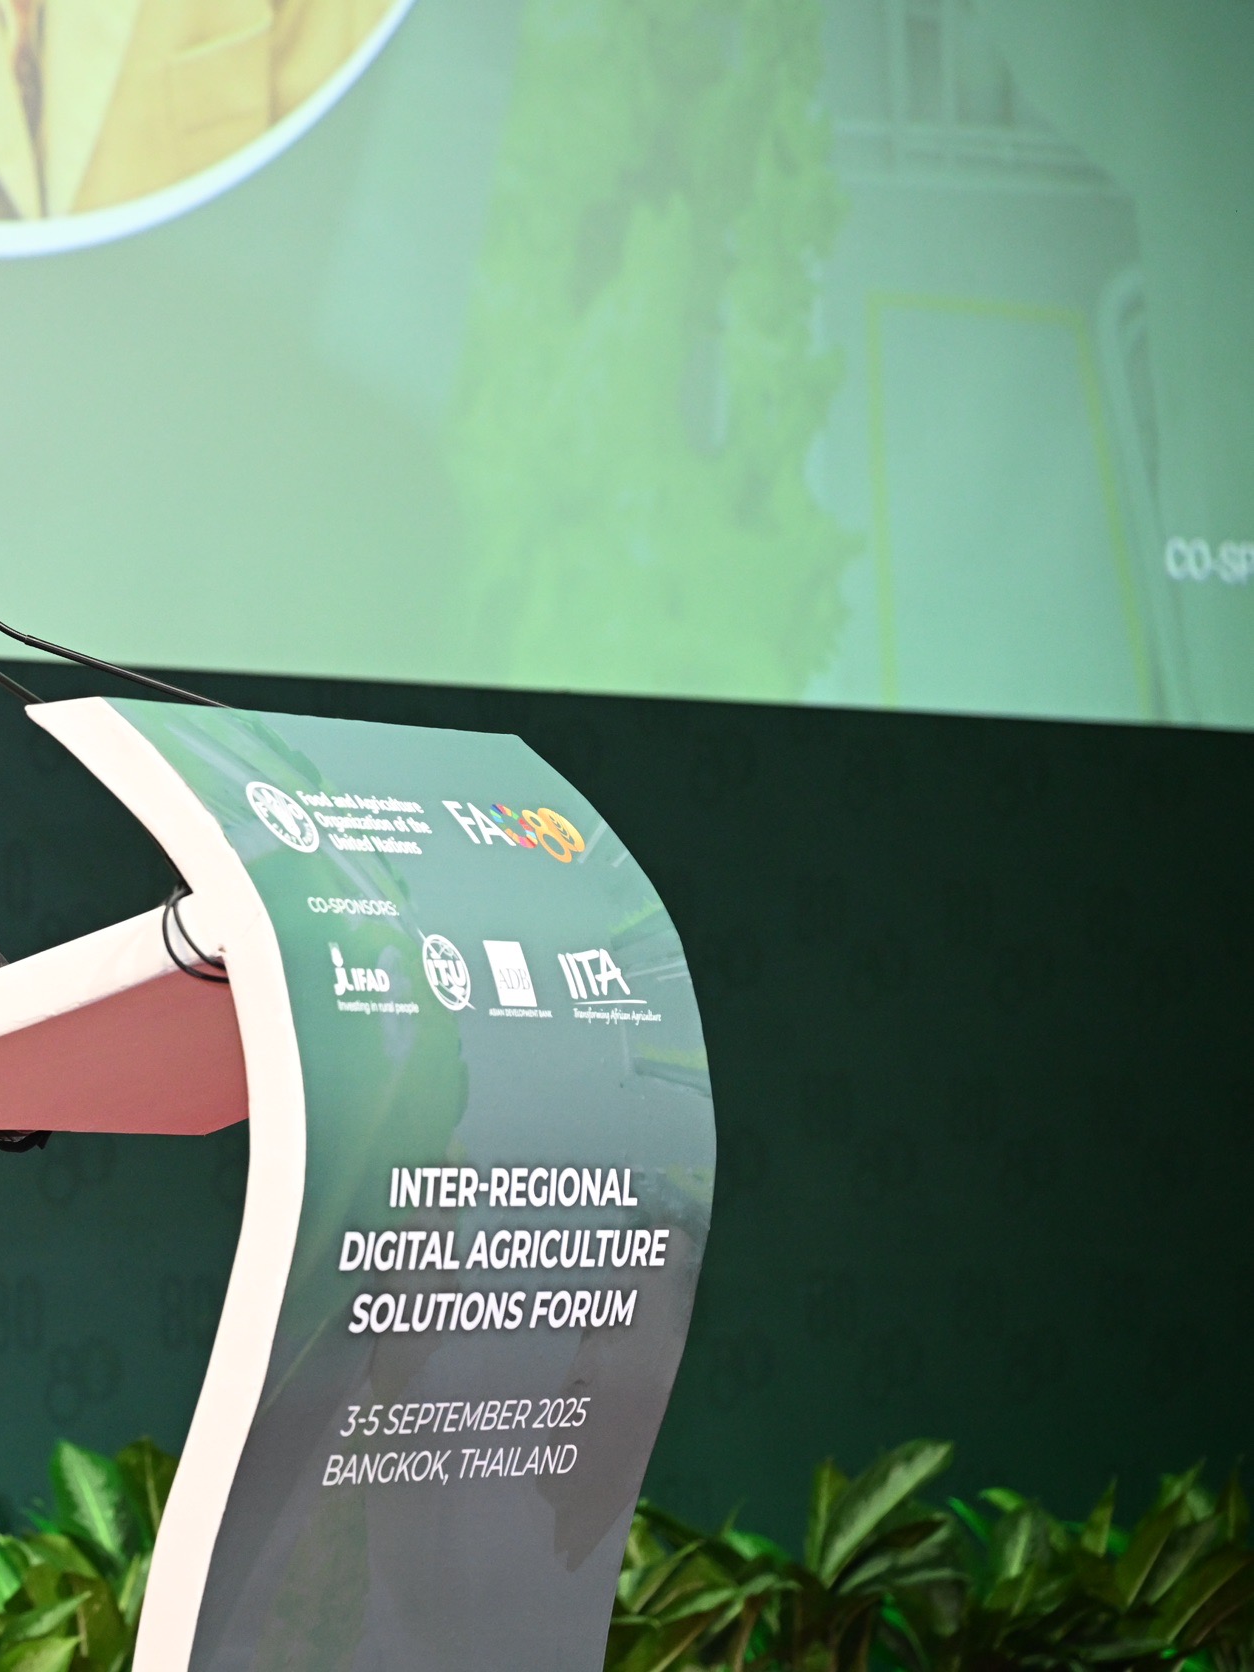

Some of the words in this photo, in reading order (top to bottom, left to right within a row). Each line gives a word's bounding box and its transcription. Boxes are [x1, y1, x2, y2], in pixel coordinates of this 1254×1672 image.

[296, 791, 334, 807] Food
[331, 793, 359, 809] and
[354, 795, 424, 814] Agriculture
[314, 811, 396, 832] Organization
[393, 815, 410, 832] of
[406, 817, 433, 834] the
[328, 833, 376, 852] United
[370, 835, 423, 855] Nations
[307, 896, 400, 916] CO-SPONSORS:
[350, 968, 390, 992] IFAD
[427, 959, 468, 987] ITU
[498, 968, 532, 990] ADB
[557, 948, 631, 999] IITA
[389, 1167, 638, 1208] INTER-REGIONAL
[338, 1231, 461, 1271] DIGITAL
[464, 1229, 670, 1270] AGRICULTURE
[348, 1291, 527, 1334] SOLUTIONS
[529, 1289, 638, 1329] FORUM
[340, 1405, 384, 1438] 3-5
[383, 1400, 532, 1436] SEPTEMBER
[532, 1397, 591, 1429] 2025
[321, 1450, 452, 1486] BANGKOK,
[458, 1444, 578, 1479] THAILAND
